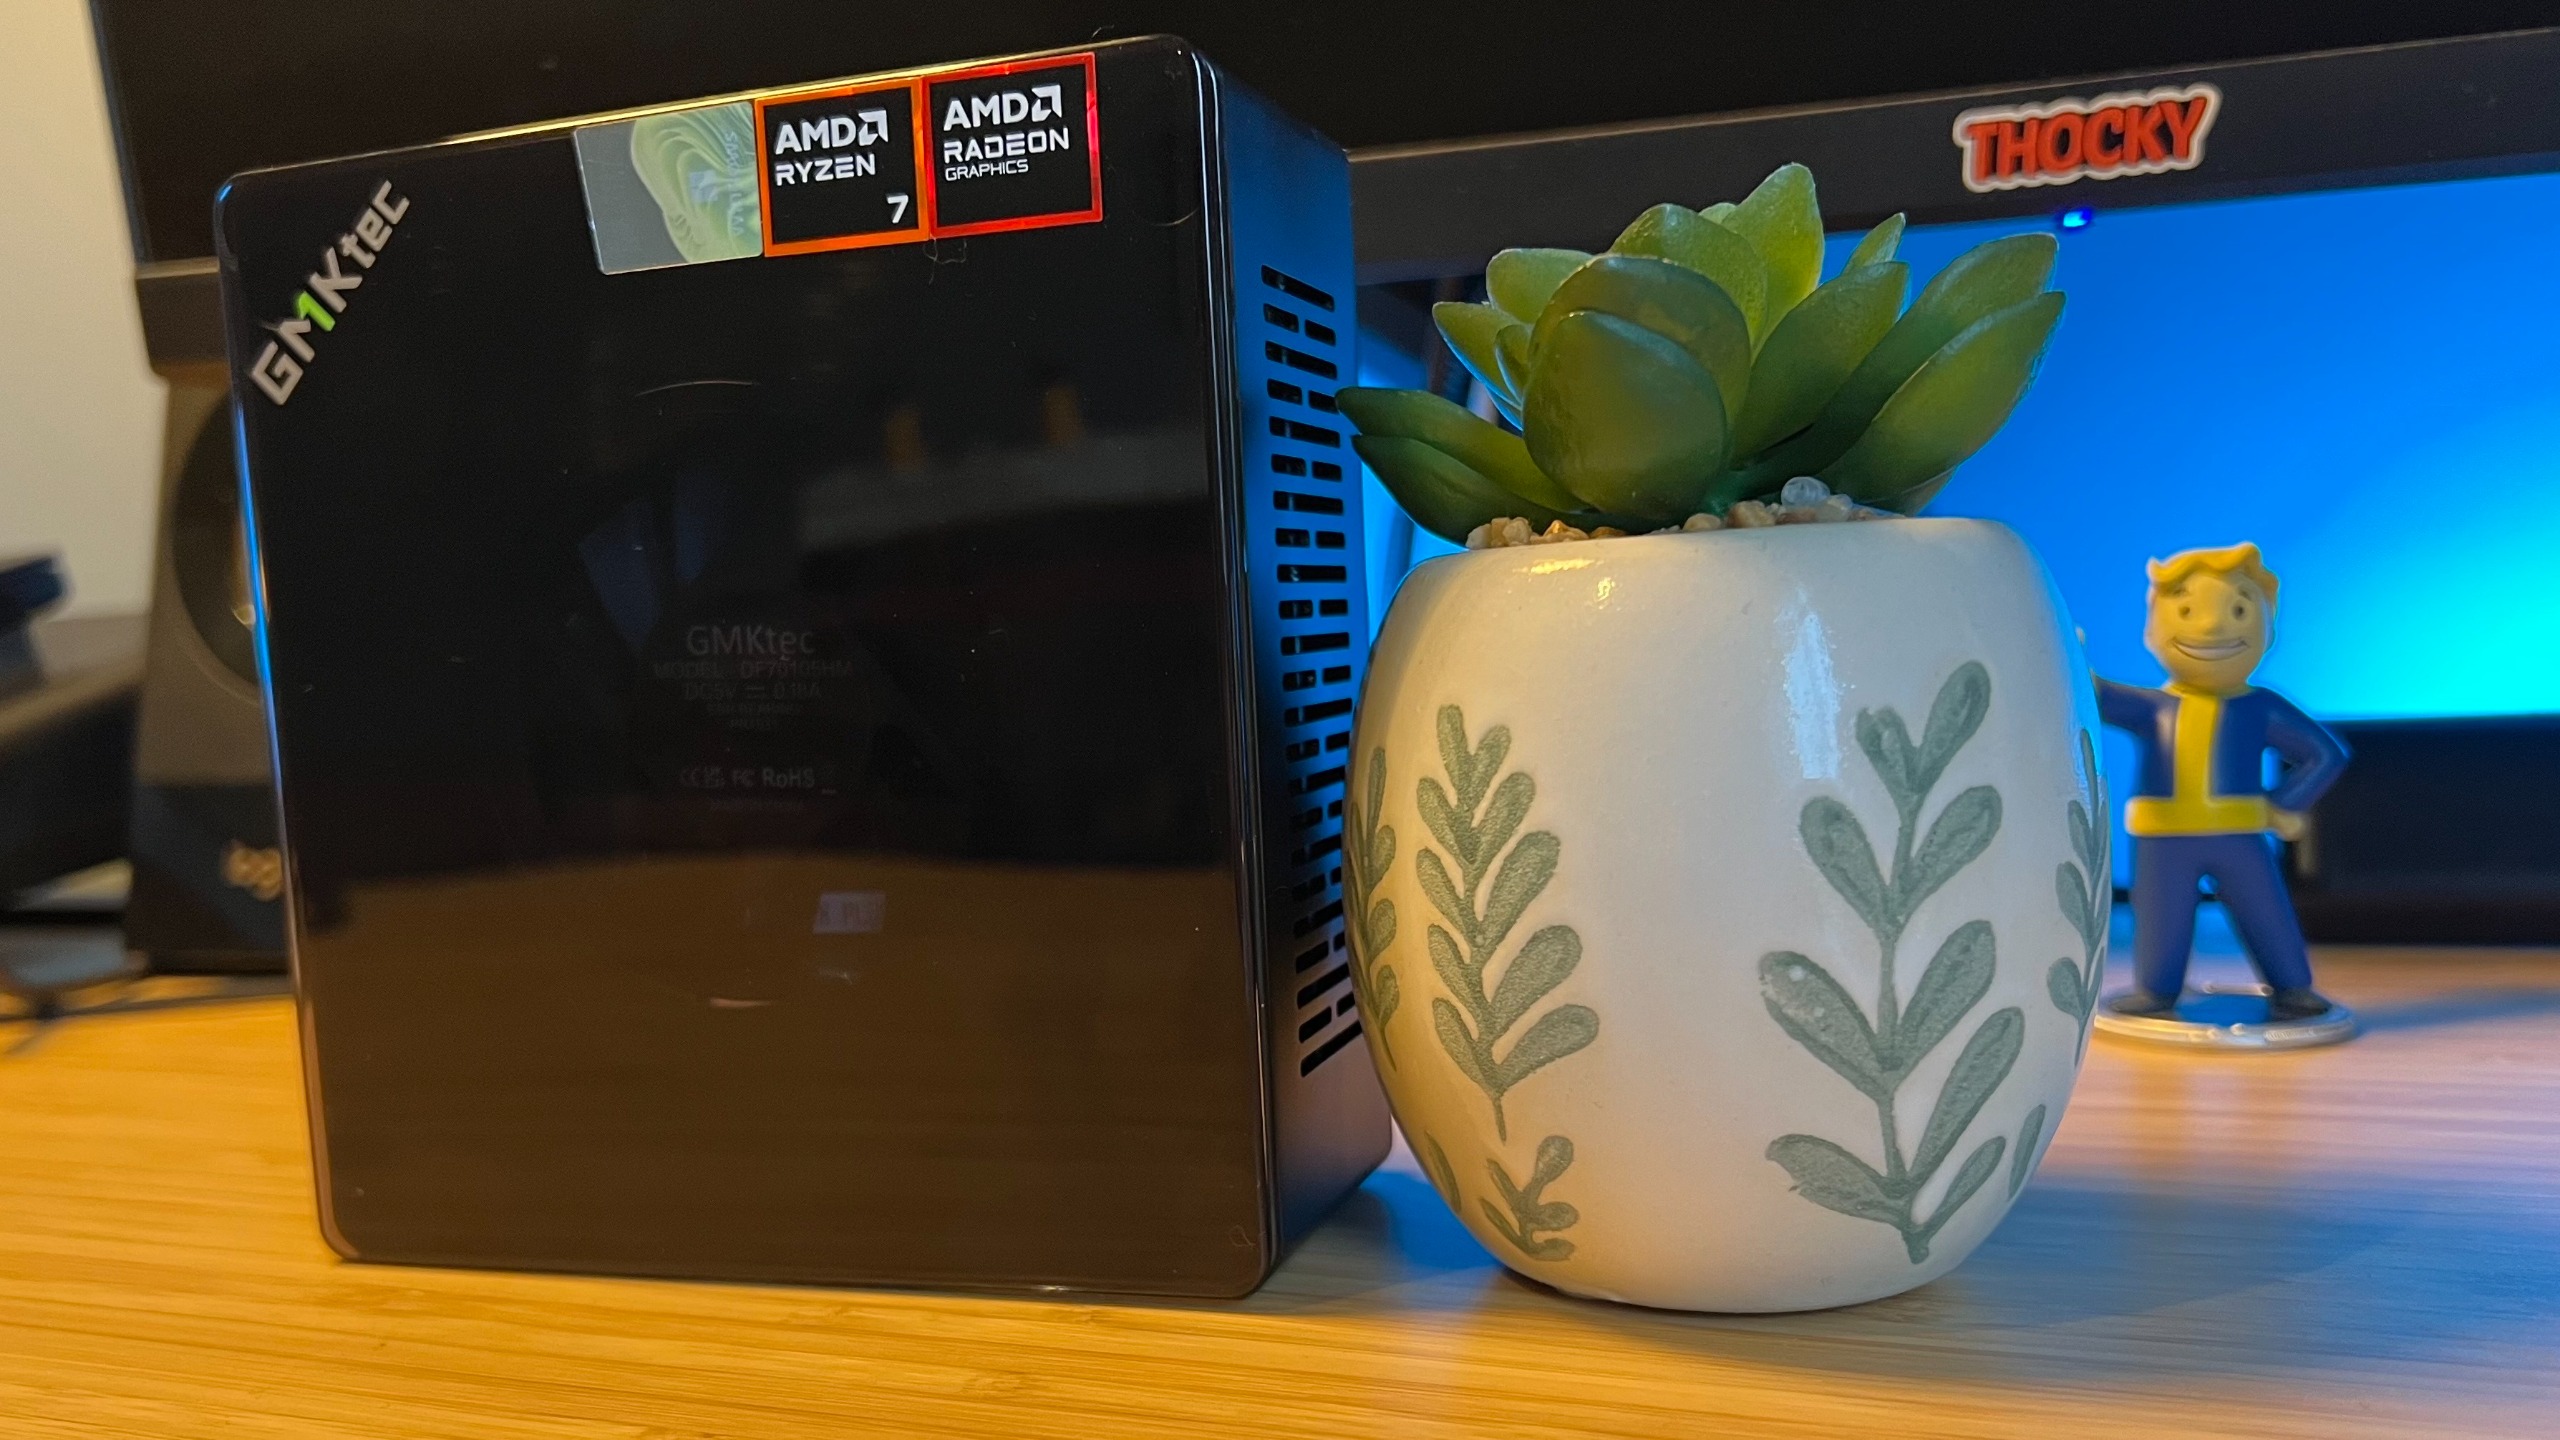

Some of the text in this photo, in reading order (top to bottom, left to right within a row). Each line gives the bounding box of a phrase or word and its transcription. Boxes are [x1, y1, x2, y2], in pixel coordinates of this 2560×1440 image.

[942, 92, 1029, 131] AMD
[774, 117, 857, 155] AMD
[943, 126, 1070, 164] RADEON
[1965, 96, 2208, 182] THOCKY
[774, 153, 876, 186] RYZEN
[944, 158, 1029, 182] GRAPHICS
[887, 191, 909, 224] 7
[250, 180, 410, 405] GMKtec
[686, 624, 816, 656] GMKtec
[761, 766, 816, 789] RoHS
